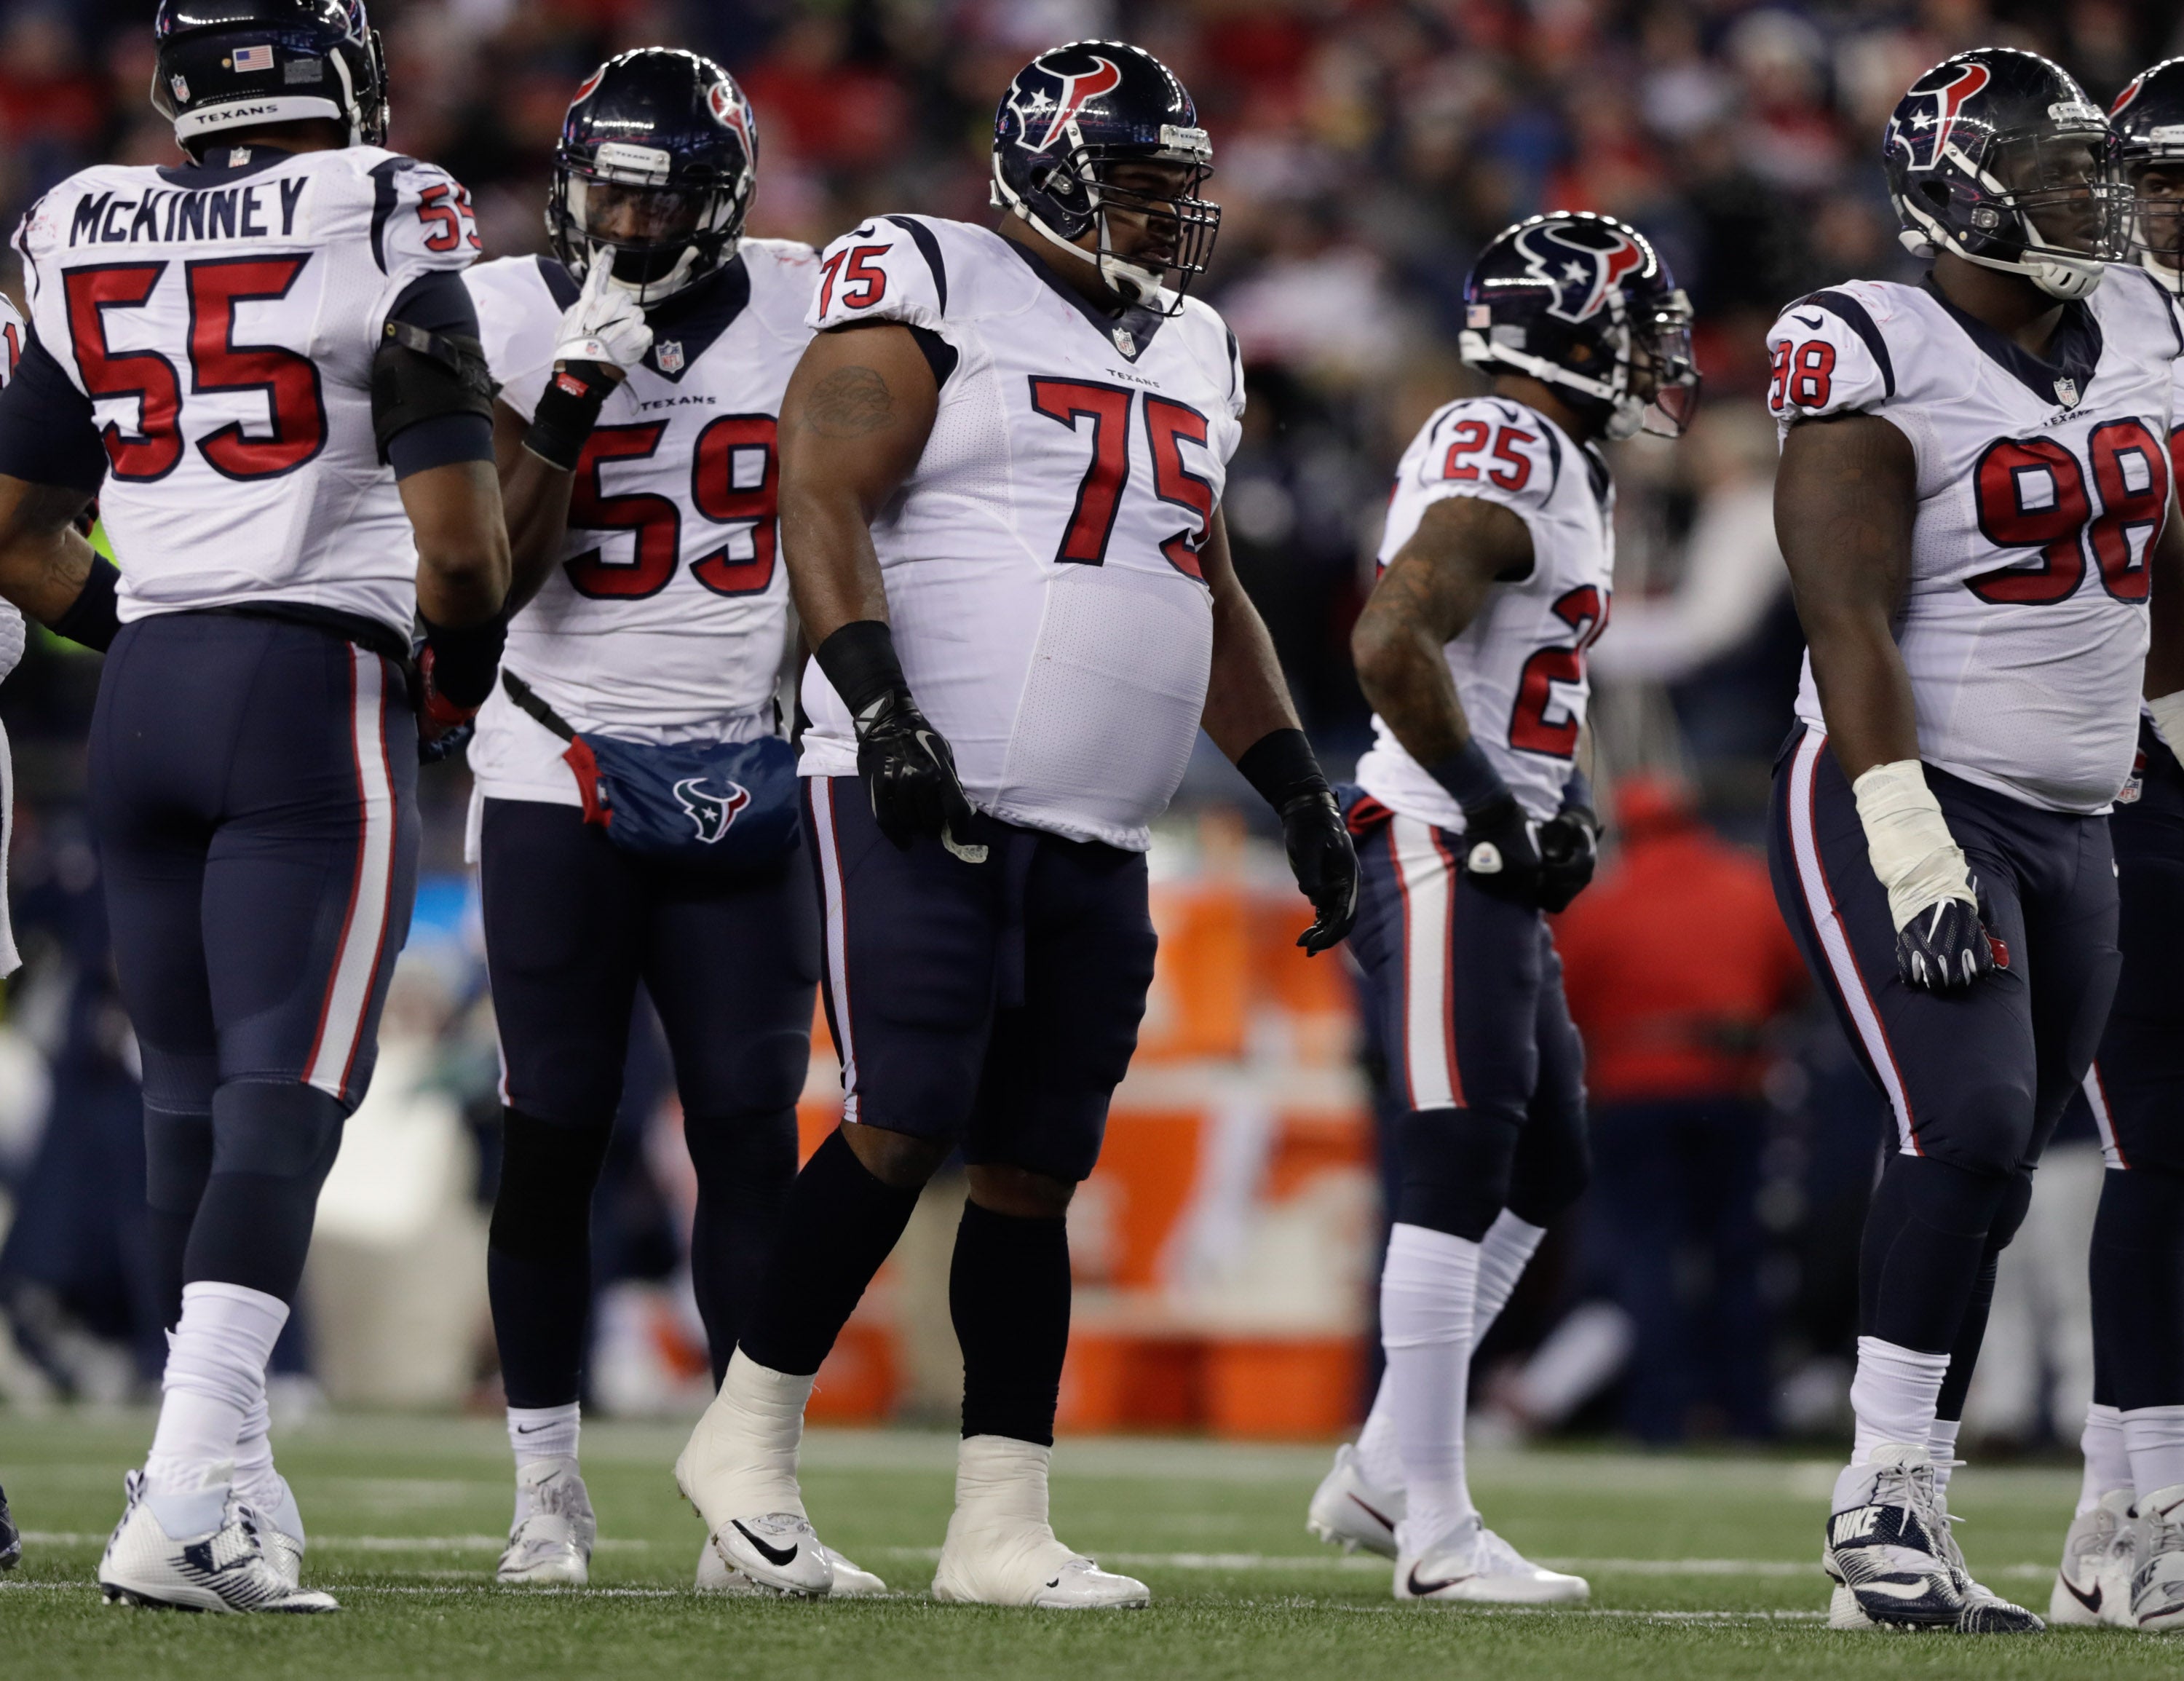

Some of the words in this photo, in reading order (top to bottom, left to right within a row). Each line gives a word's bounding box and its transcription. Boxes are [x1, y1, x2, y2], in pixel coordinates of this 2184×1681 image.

[195, 104, 278, 124] TEXANS
[416, 182, 483, 252] 55
[819, 243, 894, 320] 75
[62, 252, 328, 483] 55
[662, 354, 681, 368] NFL
[1105, 368, 1160, 388] TEXANS
[1770, 339, 1837, 411] 98
[641, 396, 716, 411] TEXANS
[1027, 374, 1212, 585] 75
[1443, 420, 1536, 492] 25
[563, 413, 780, 601] 59
[1963, 416, 2169, 606] 98
[1507, 584, 1611, 761] 2
[1832, 1506, 1884, 1549] NIKE
